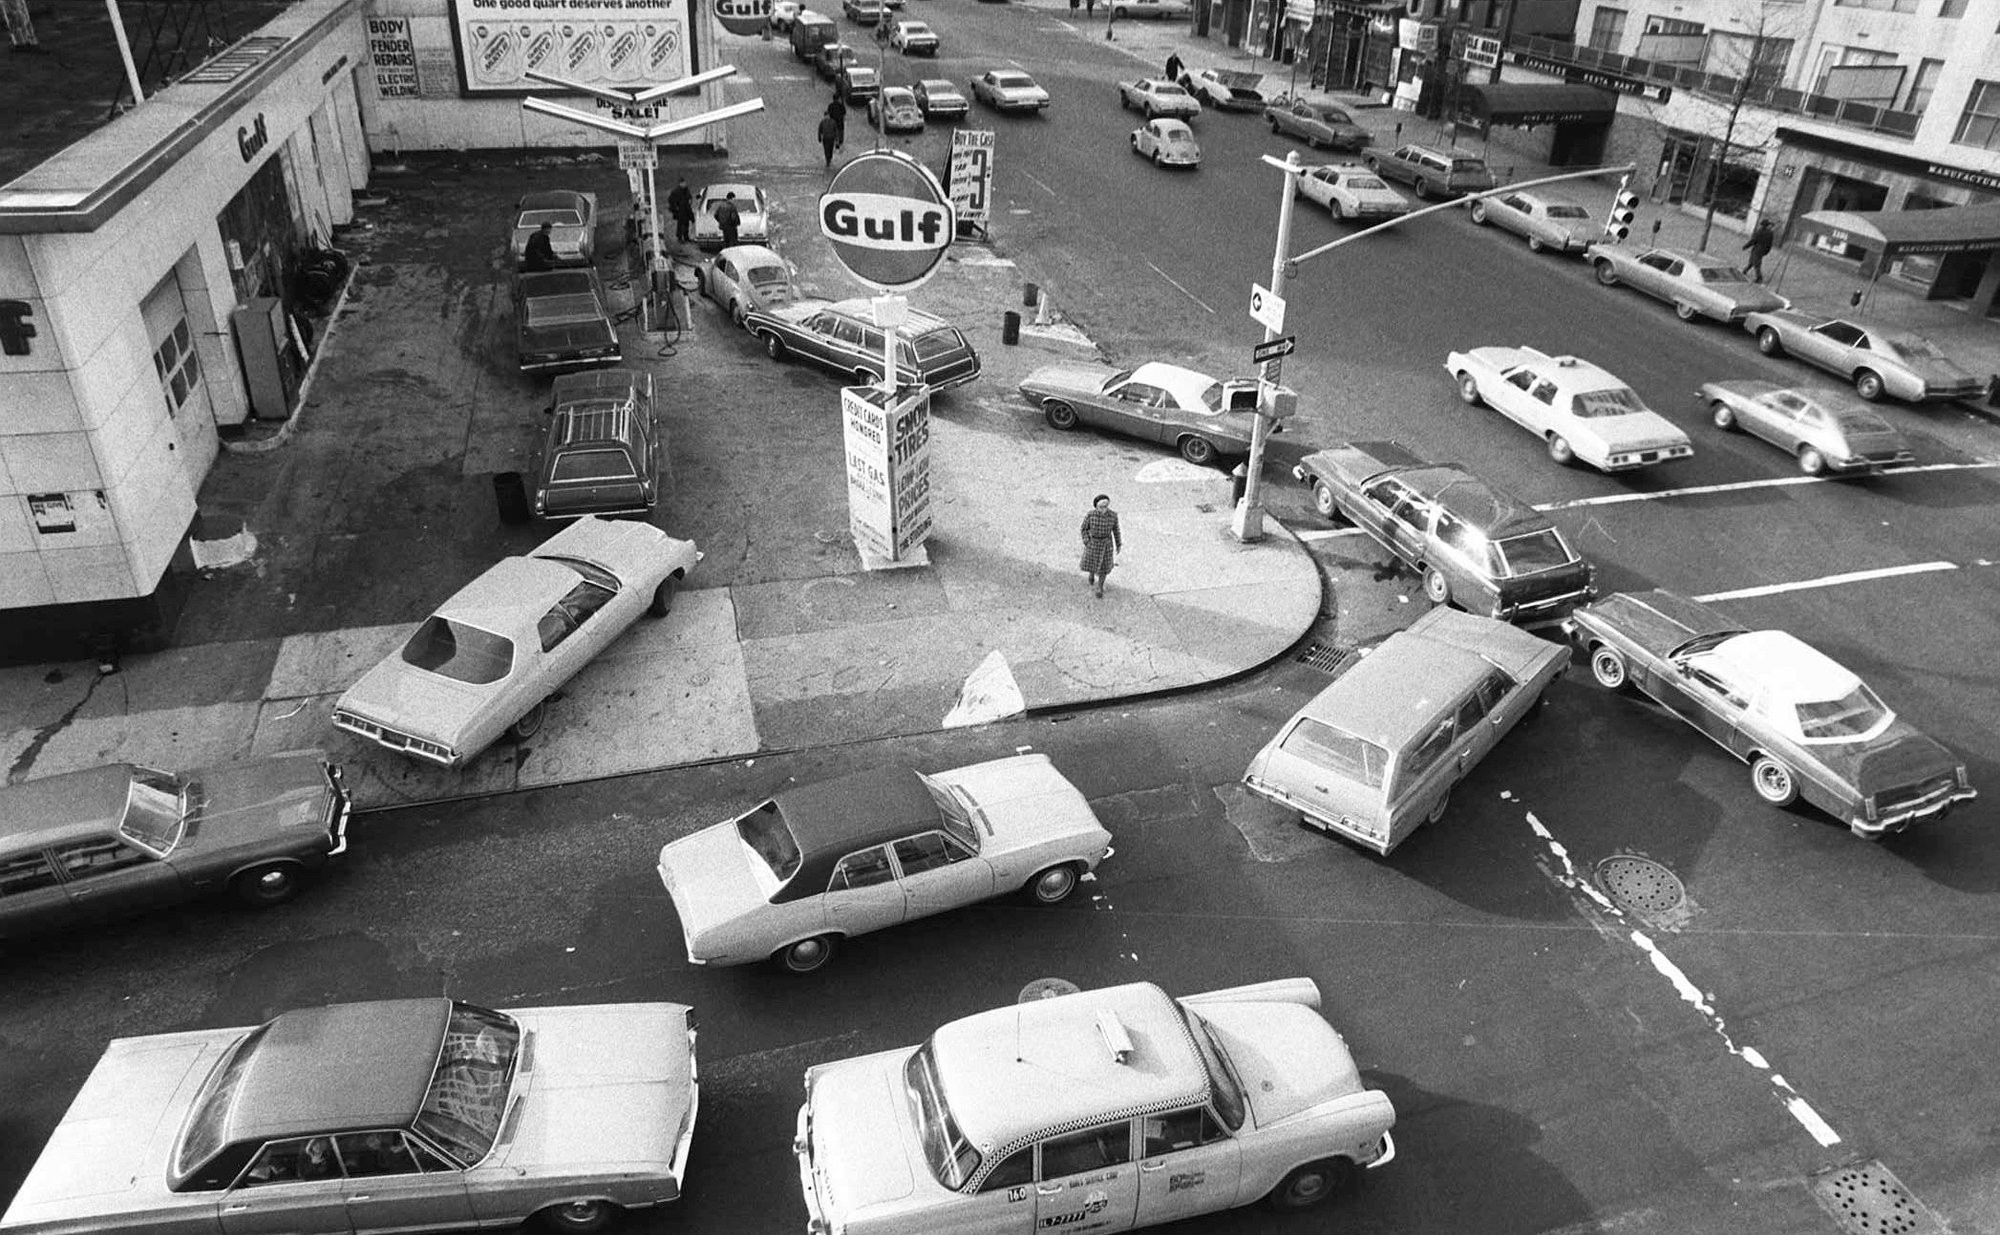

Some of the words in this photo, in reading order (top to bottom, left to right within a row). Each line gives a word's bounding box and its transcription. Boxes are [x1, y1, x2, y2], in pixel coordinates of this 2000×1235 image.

[474, 0, 498, 8] One
[500, 0, 531, 10] good
[533, 0, 567, 10] quart
[569, 0, 622, 9] deserves
[625, 0, 671, 9] another
[716, 0, 772, 15] Gulf
[369, 21, 403, 33] BODY
[371, 40, 410, 52] FENDER
[374, 54, 413, 66] REPAIRS
[611, 107, 659, 118] SALE!
[238, 112, 267, 163] Gulf
[824, 200, 942, 244] Gulf
[844, 398, 862, 420] CREDIT
[864, 410, 883, 431] CARDS
[896, 397, 928, 442] SNOW
[850, 418, 880, 444] HONORED
[895, 420, 928, 465] TIRES
[848, 451, 865, 474] LAST
[868, 465, 885, 486] GAS
[898, 471, 929, 518] PRICES
[1009, 1188, 1026, 1202] 160
